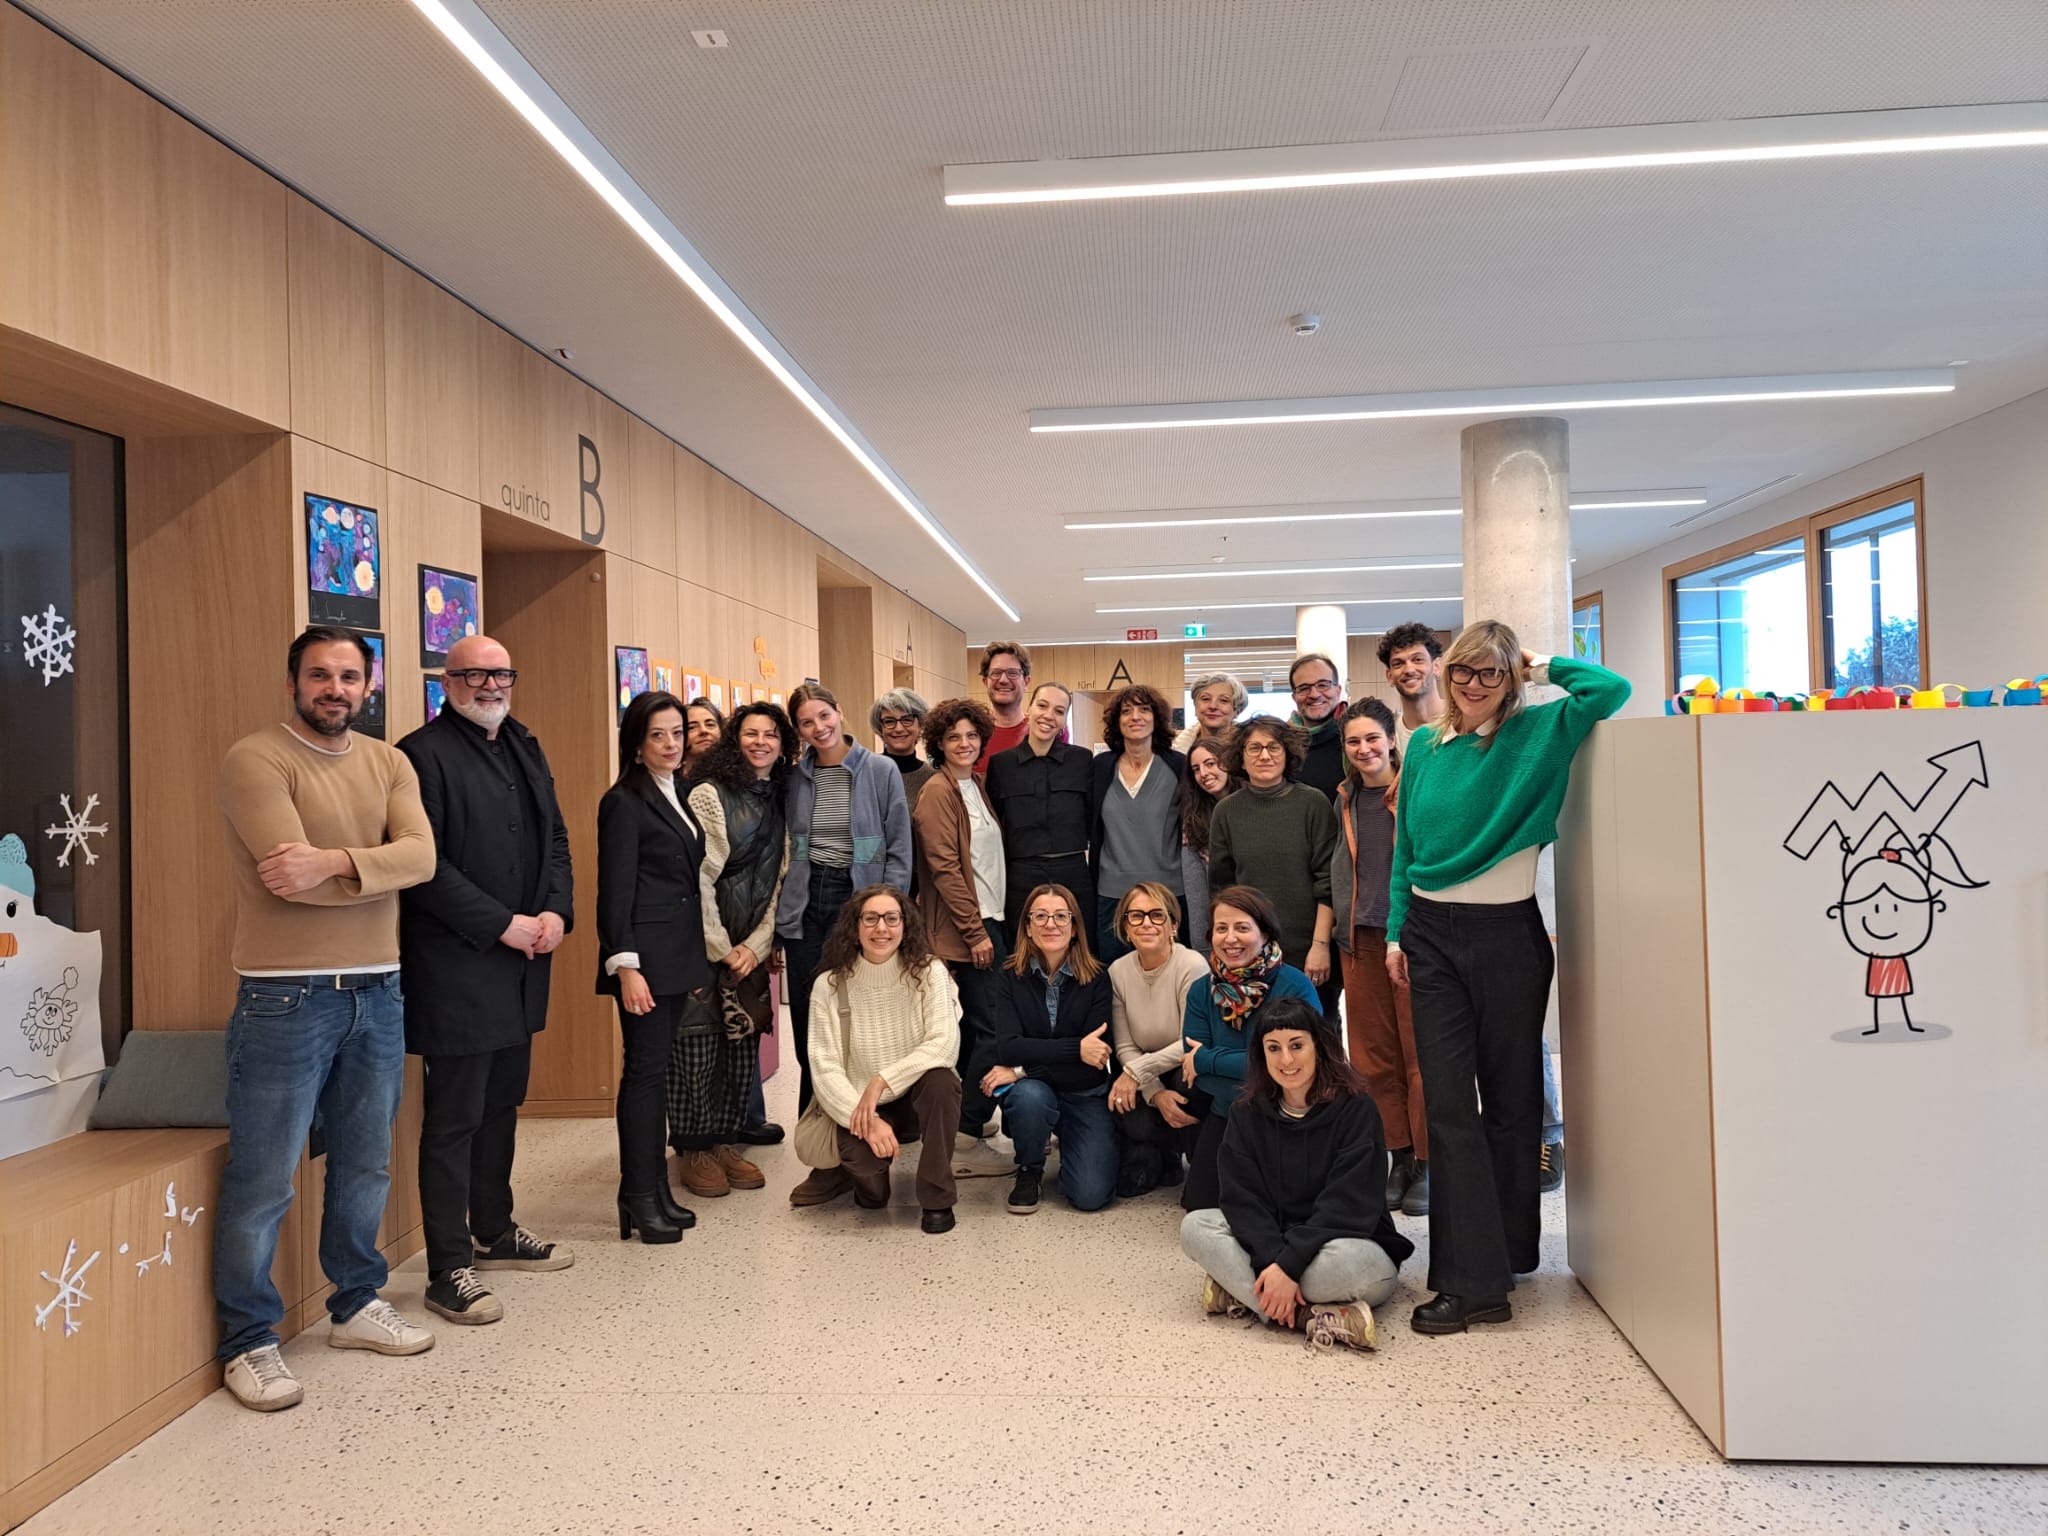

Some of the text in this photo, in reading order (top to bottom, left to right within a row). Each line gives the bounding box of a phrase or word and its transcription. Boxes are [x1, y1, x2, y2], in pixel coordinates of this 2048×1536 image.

[501, 433, 605, 546] quinta B
[1106, 658, 1134, 691] A
